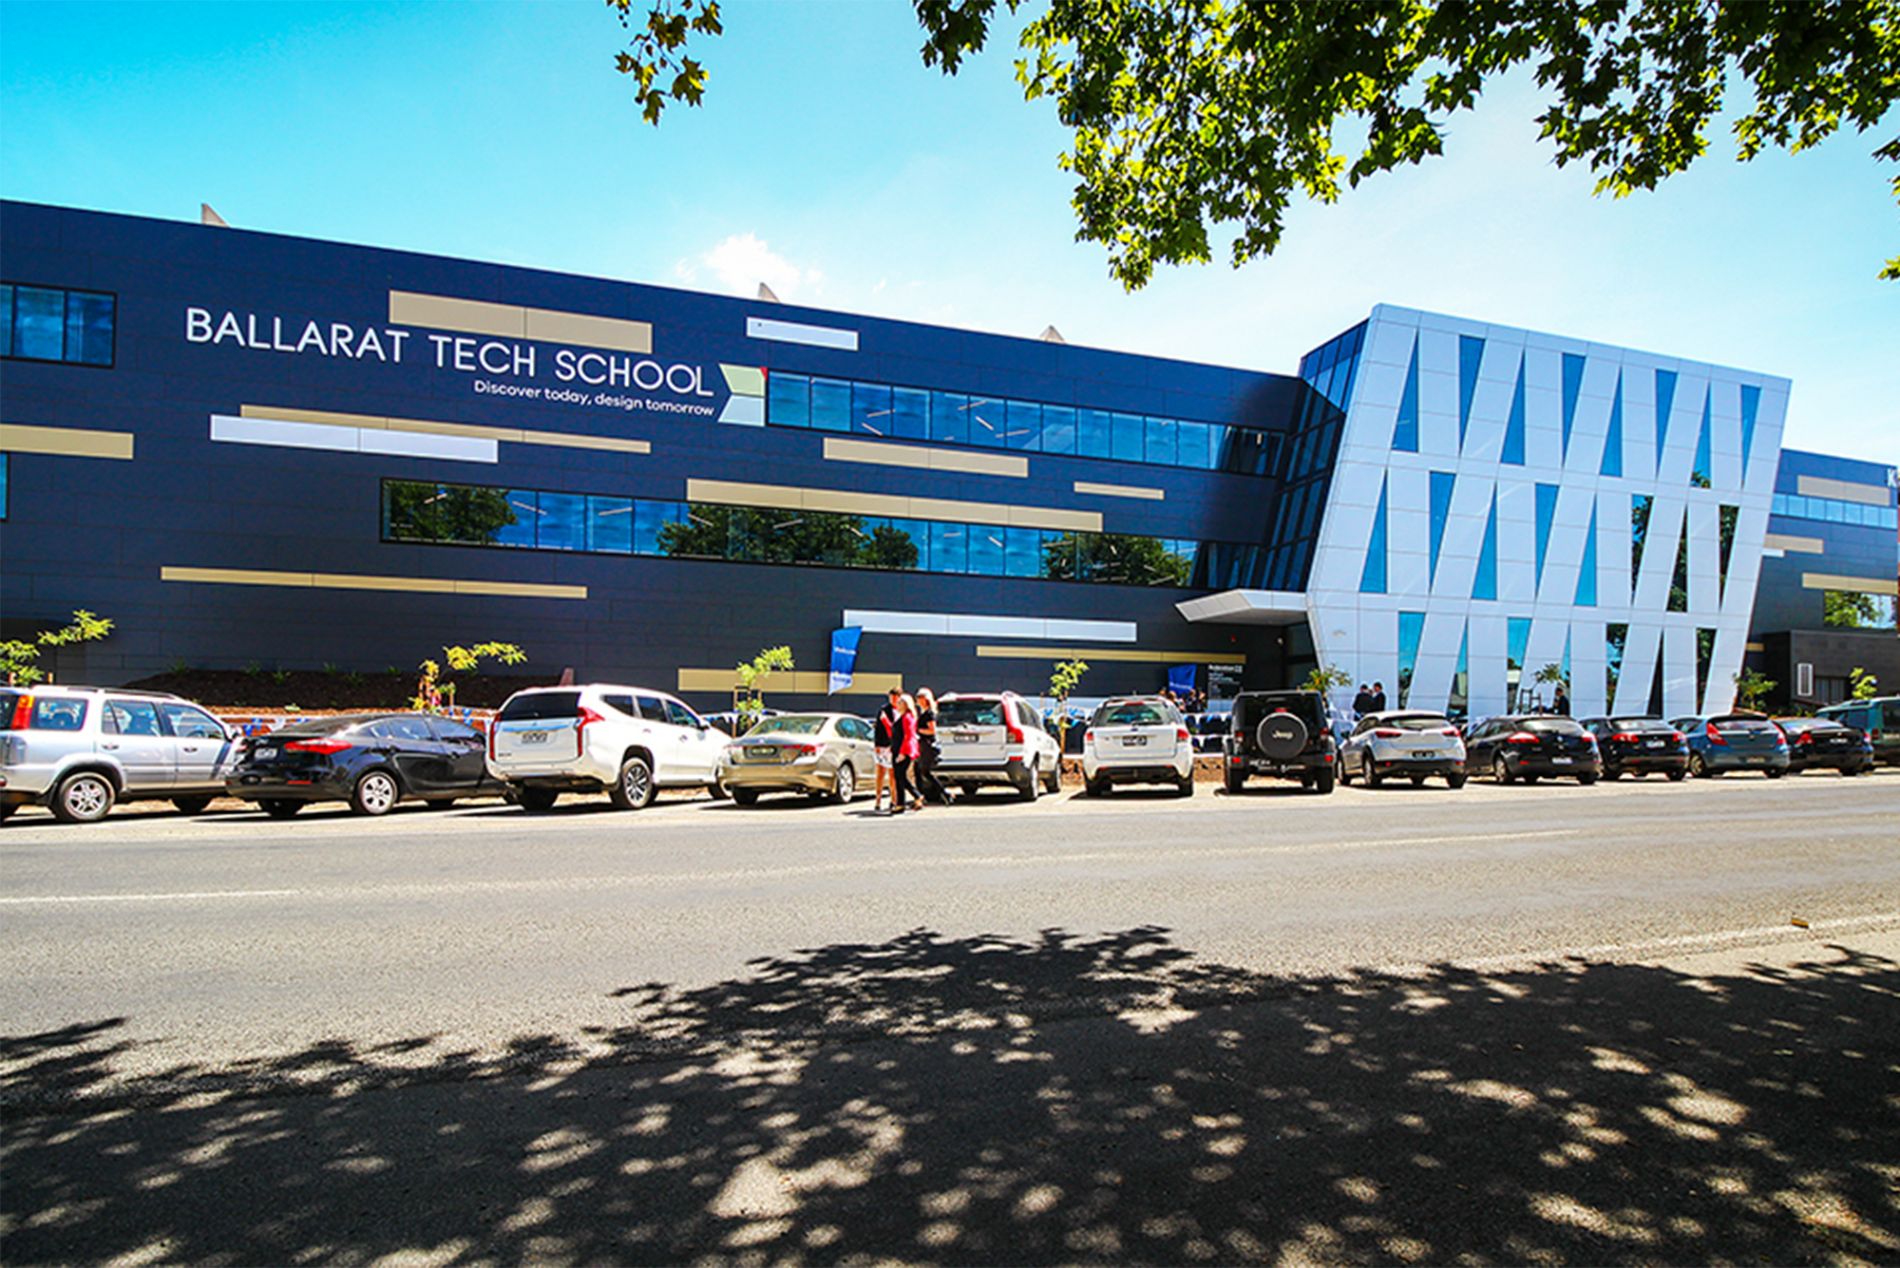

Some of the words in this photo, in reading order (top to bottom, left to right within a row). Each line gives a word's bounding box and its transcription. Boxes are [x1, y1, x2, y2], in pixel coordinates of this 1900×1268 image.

[186, 307, 410, 362] BALLARAT
[428, 334, 535, 377] TECH
[554, 349, 714, 397] SCHOOL
[473, 379, 542, 400] Discover
[543, 387, 593, 406] today,
[594, 393, 643, 412] design
[645, 399, 715, 416] tomorrow
[1272, 730, 1294, 740] Jeep
